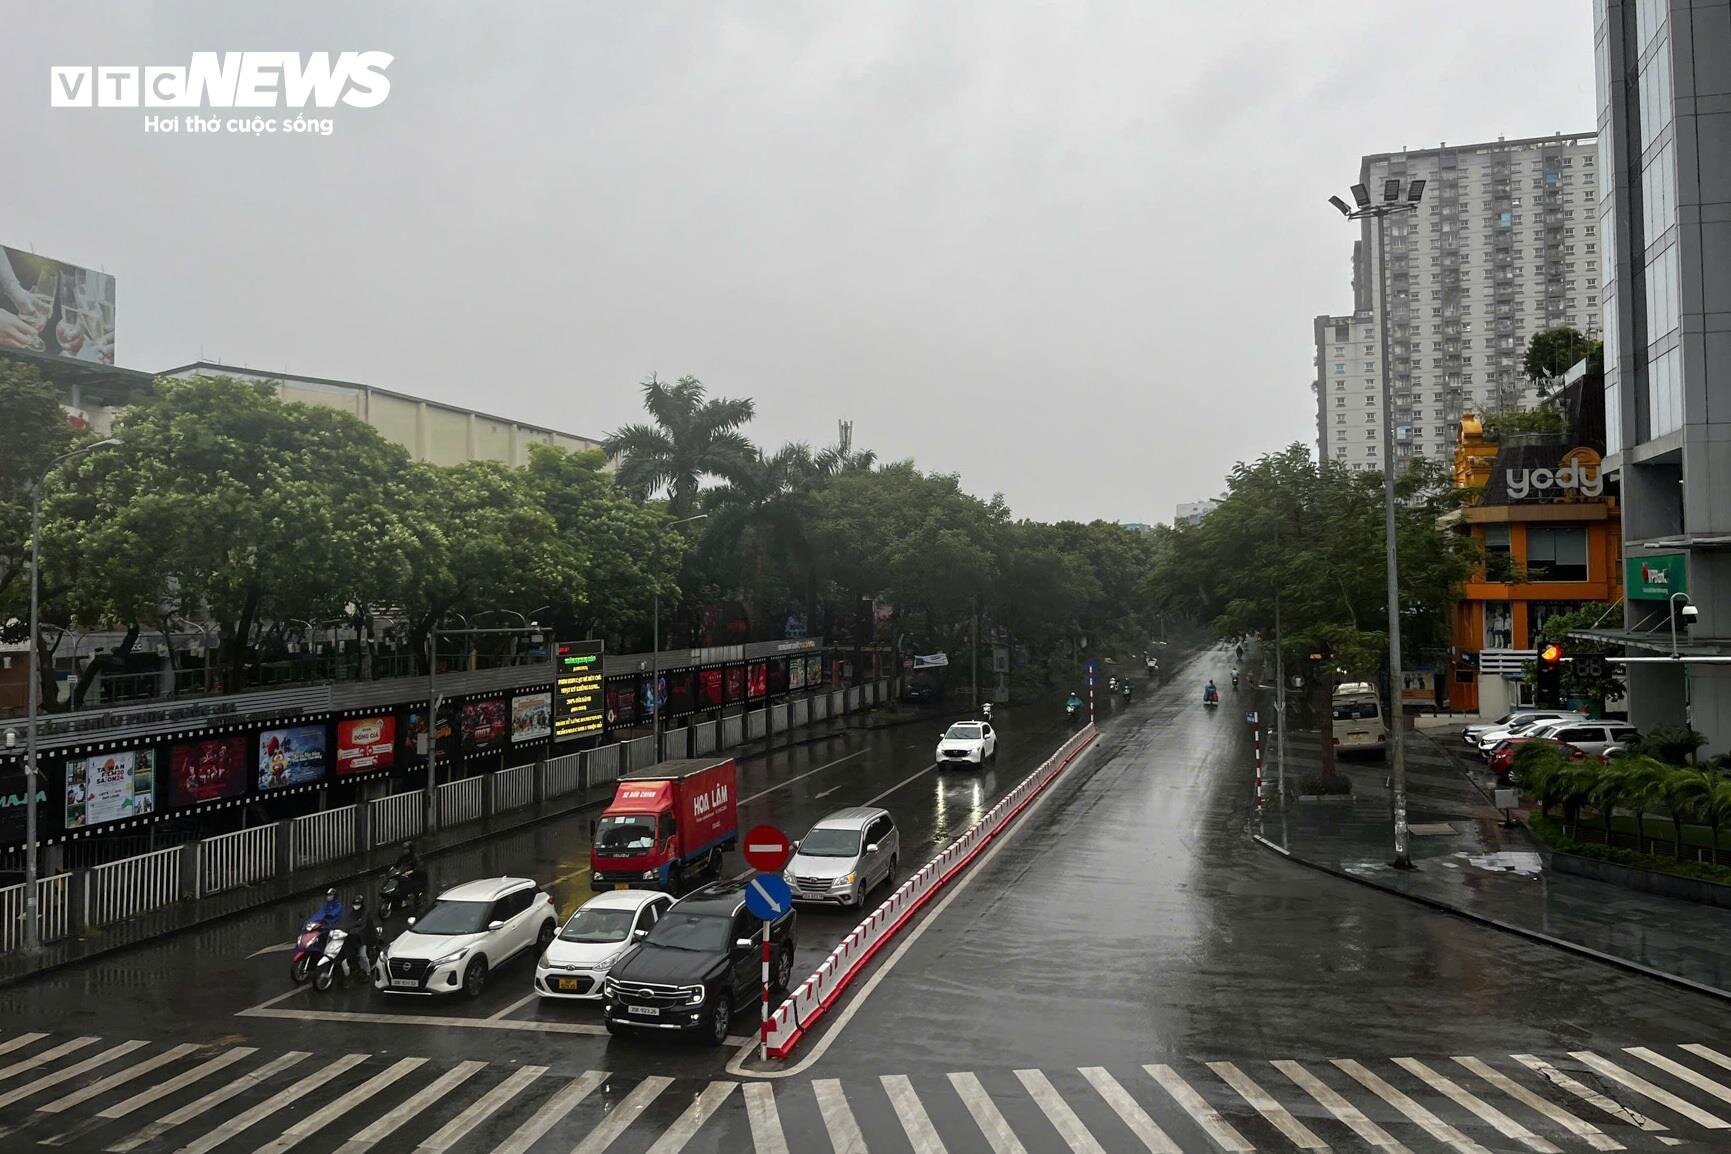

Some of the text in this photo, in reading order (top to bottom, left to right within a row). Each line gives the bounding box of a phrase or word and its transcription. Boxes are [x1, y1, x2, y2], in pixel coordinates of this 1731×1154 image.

[1506, 458, 1604, 499] yody
[693, 793, 710, 817] HOA
[711, 783, 728, 808] LÂM
